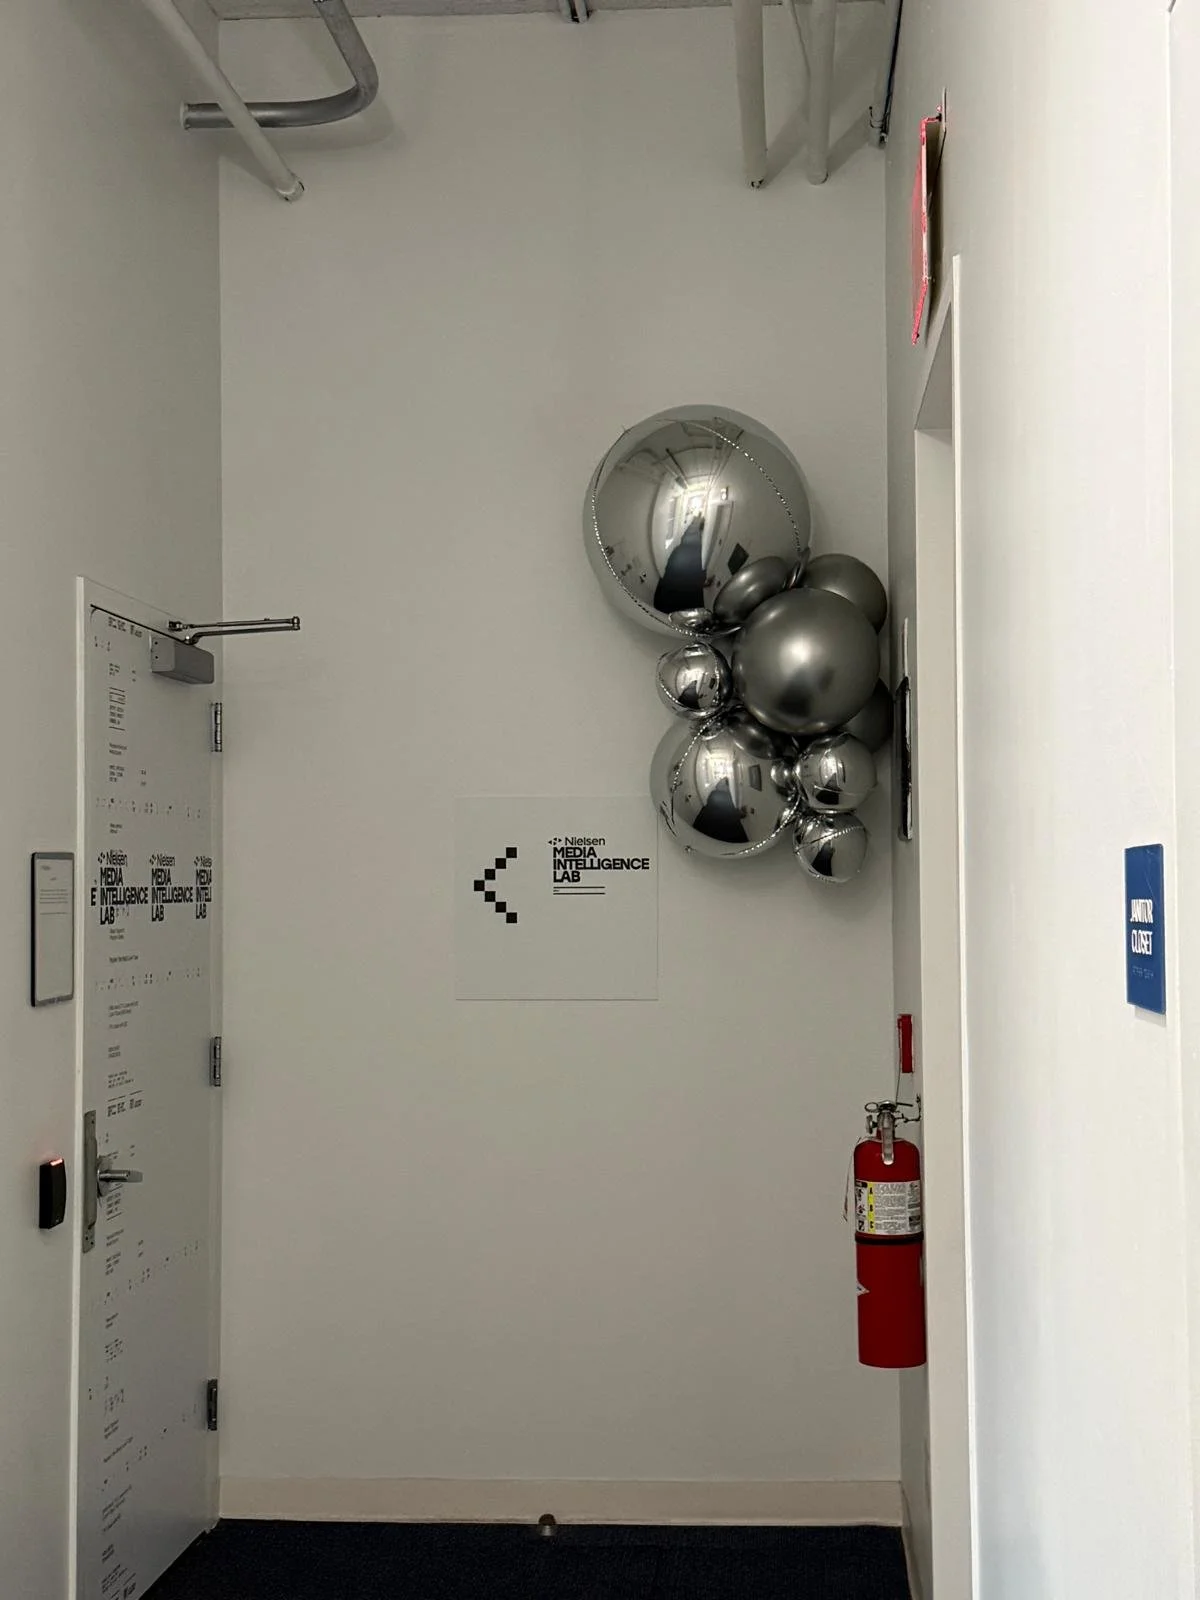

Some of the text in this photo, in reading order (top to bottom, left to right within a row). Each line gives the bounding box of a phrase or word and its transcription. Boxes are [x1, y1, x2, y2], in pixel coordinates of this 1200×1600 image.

[565, 837, 605, 846] Nielsen
[106, 851, 128, 867] Nielsen
[553, 847, 597, 858] MEDIA
[553, 858, 650, 870] INTELLIGENCE
[100, 867, 123, 886] MEDIA
[151, 868, 172, 886] MEDIA
[553, 870, 581, 883] LAB
[100, 887, 149, 906] INTELLIGENCE
[151, 887, 194, 904] INTELLIGENCE
[100, 906, 115, 925] LAB
[151, 905, 165, 922] LAB
[196, 904, 207, 919] LAB
[1130, 899, 1153, 923] JANITOR
[1131, 929, 1153, 955] CLOSET
